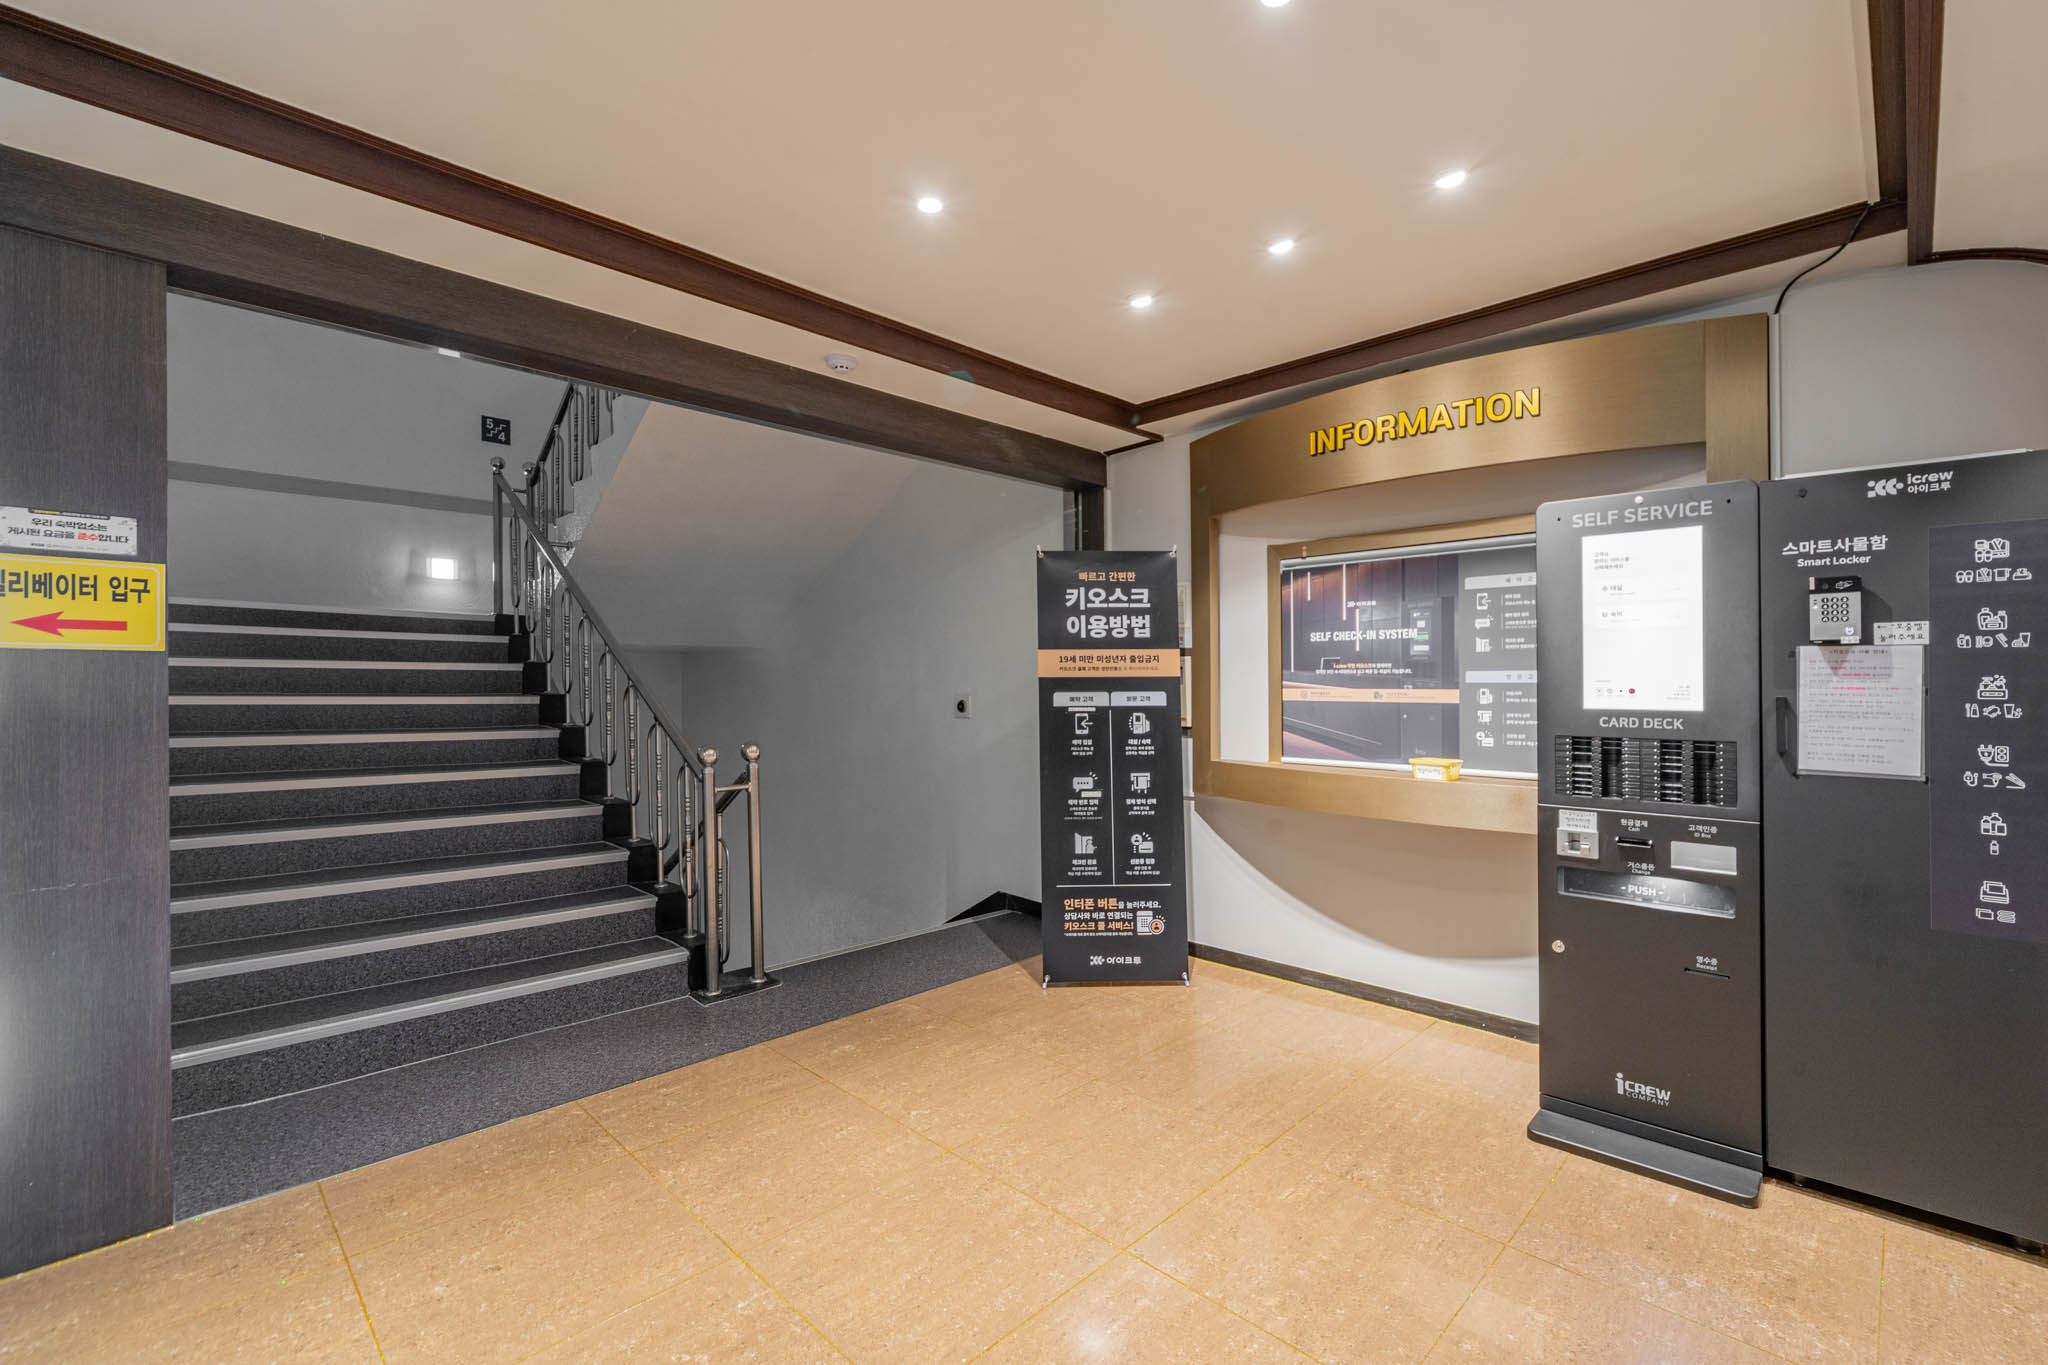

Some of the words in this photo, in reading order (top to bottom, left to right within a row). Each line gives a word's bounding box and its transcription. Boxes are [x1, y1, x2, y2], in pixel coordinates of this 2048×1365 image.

[486, 418, 494, 429] 5
[1309, 387, 1541, 456] INFORMATION
[498, 432, 506, 442] 4
[1907, 471, 1954, 484] icrew
[1907, 482, 1952, 495] 아이크루
[1572, 509, 1618, 528] SELF
[1623, 500, 1713, 524] SERVICE
[31, 518, 52, 528] 우리
[56, 520, 108, 532] 숙박업소는
[8, 526, 41, 537] 게시된
[43, 530, 75, 540] 요금을
[77, 532, 129, 544] 준수합니다
[1781, 535, 1889, 557] 스마트사물함
[1797, 557, 1831, 568] Smart
[1832, 555, 1872, 566] Locker
[1078, 571, 1107, 582] 빠르고
[1108, 571, 1137, 582] 간편한
[109, 576, 151, 603] 입구
[1065, 586, 1151, 611] 키오스크
[1066, 614, 1151, 639] 이용방법
[1310, 631, 1332, 642] SELF
[1333, 629, 1377, 642] CHECK-IN
[1378, 628, 1418, 640] SYSTEM
[1059, 655, 1076, 664] 19세
[1079, 655, 1094, 664] 미만
[1096, 655, 1127, 664] 미성년자
[1129, 654, 1160, 664] 출입금지
[1599, 716, 1640, 729] CARD
[1643, 717, 1684, 730] DECK
[1620, 818, 1649, 829] 현금결제
[1687, 824, 1718, 835] 고객인증
[1627, 861, 1656, 872] 거스름돈
[1064, 897, 1095, 910] 인터폰
[1097, 897, 1125, 910] 버튼을
[1126, 900, 1162, 909] 눌러주세요.
[1064, 912, 1091, 920] 상담사와
[1092, 912, 1106, 920] 바로
[1106, 911, 1134, 920] 연결되는
[1064, 921, 1096, 931] 키오스크
[1107, 921, 1134, 931] 서비스!
[1106, 956, 1142, 965] 아이크루
[1696, 956, 1718, 966] 영수증
[1625, 1091, 1670, 1107] COMPANY
